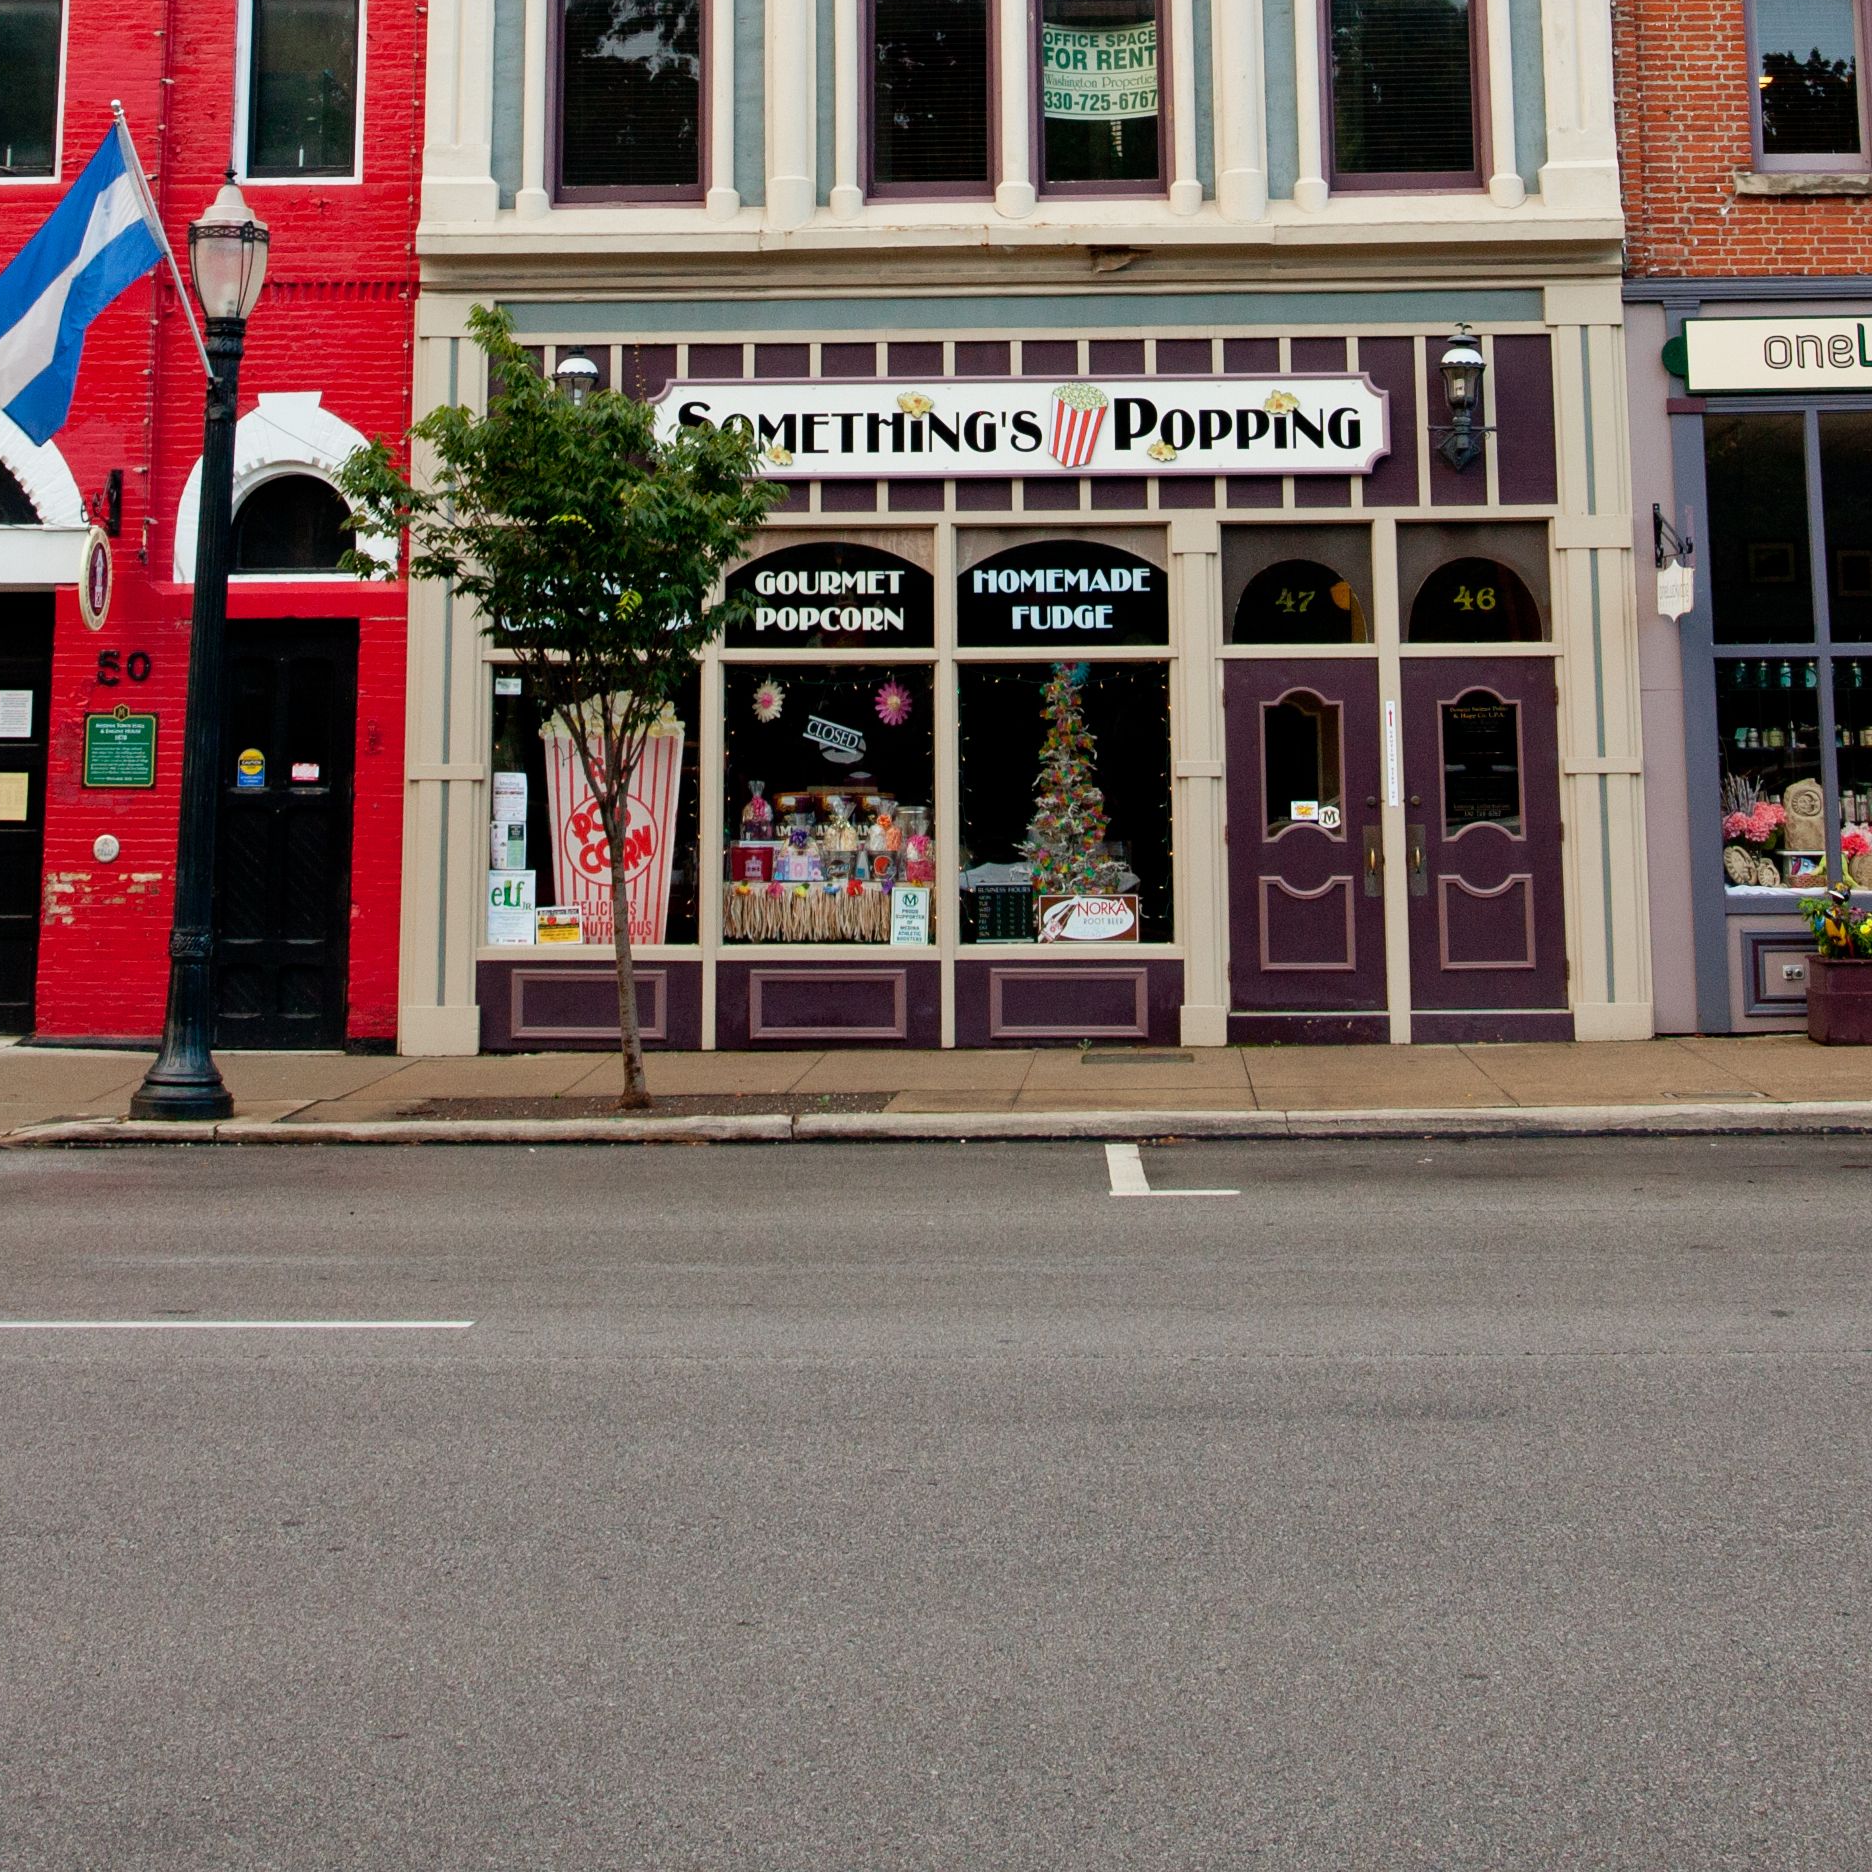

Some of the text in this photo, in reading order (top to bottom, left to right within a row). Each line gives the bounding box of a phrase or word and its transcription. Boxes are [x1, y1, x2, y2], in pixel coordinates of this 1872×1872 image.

[1043, 29, 1156, 48] OFFICE SPACE
[1043, 45, 1157, 70] FOR RENT
[1044, 73, 1098, 92] Washington
[1044, 88, 1158, 111] 330-725-6767
[755, 570, 905, 596] GOURMET
[973, 567, 1151, 594] HOMEMADE
[1275, 587, 1316, 613] 47
[1453, 585, 1496, 611] 46
[755, 605, 905, 631] POPCORN
[1012, 604, 1113, 630] FUDGE
[96, 649, 152, 687] 50
[806, 720, 860, 751] CLOSED
[579, 825, 654, 874] CORN
[573, 900, 637, 917] ELICIS
[1078, 897, 1129, 918] NORKA
[582, 920, 652, 937] NUTROUS
[1083, 917, 1125, 925] ROOT BEER
